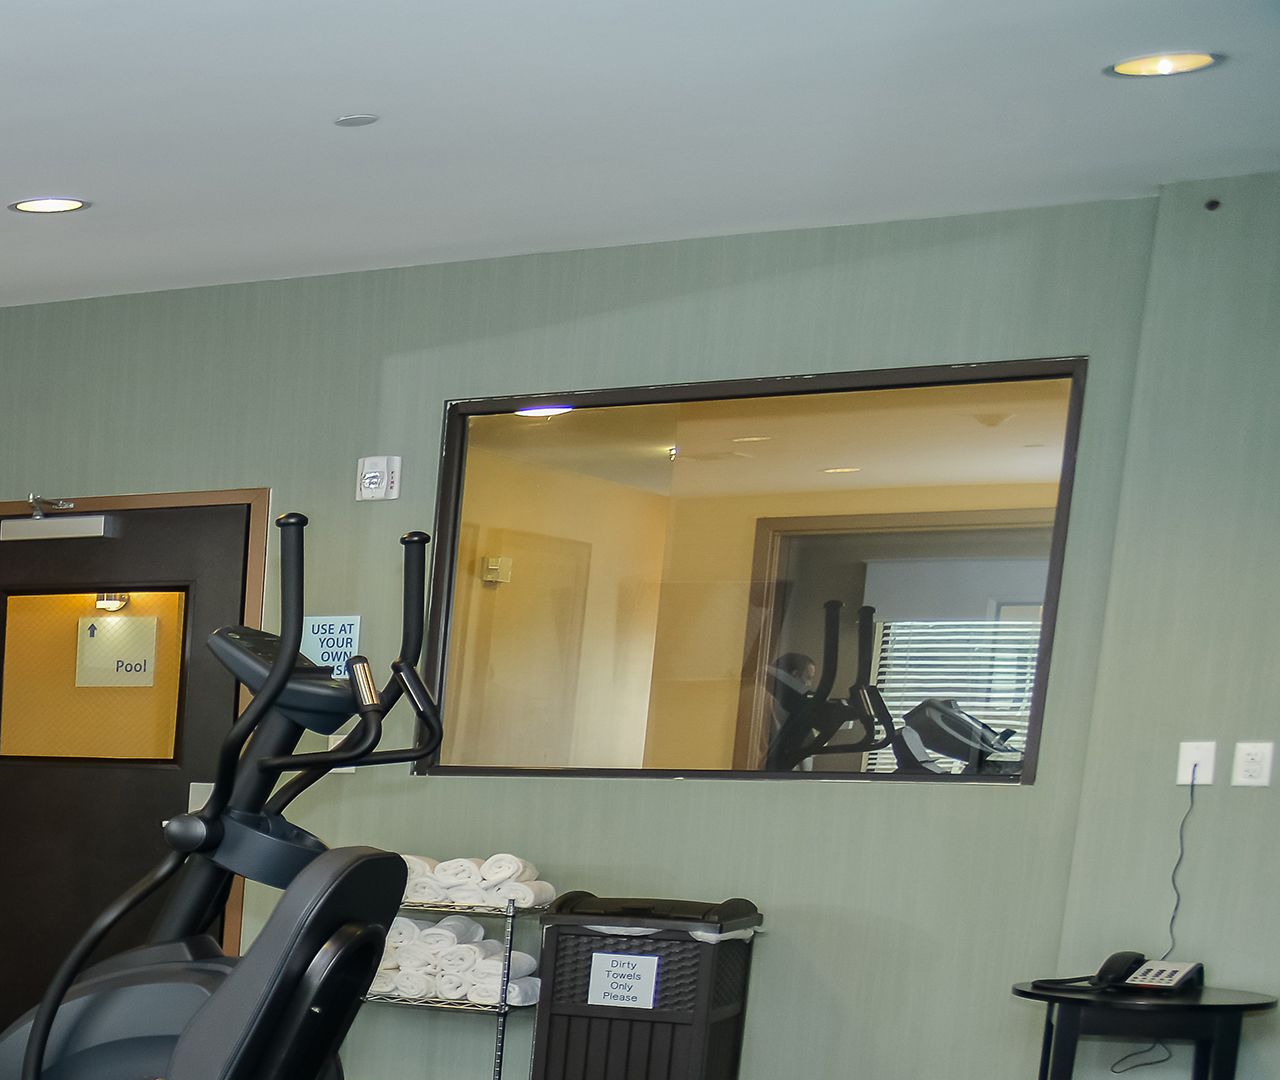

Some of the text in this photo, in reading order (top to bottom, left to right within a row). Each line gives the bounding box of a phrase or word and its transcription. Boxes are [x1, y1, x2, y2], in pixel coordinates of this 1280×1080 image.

[311, 623, 354, 635] USE AT
[319, 637, 353, 648] YOUR
[321, 651, 352, 662] OWN
[116, 659, 147, 673] Pool
[611, 960, 637, 970] Dirty
[605, 970, 642, 981] Towels
[610, 981, 634, 992] Only
[602, 991, 638, 1002] Please
